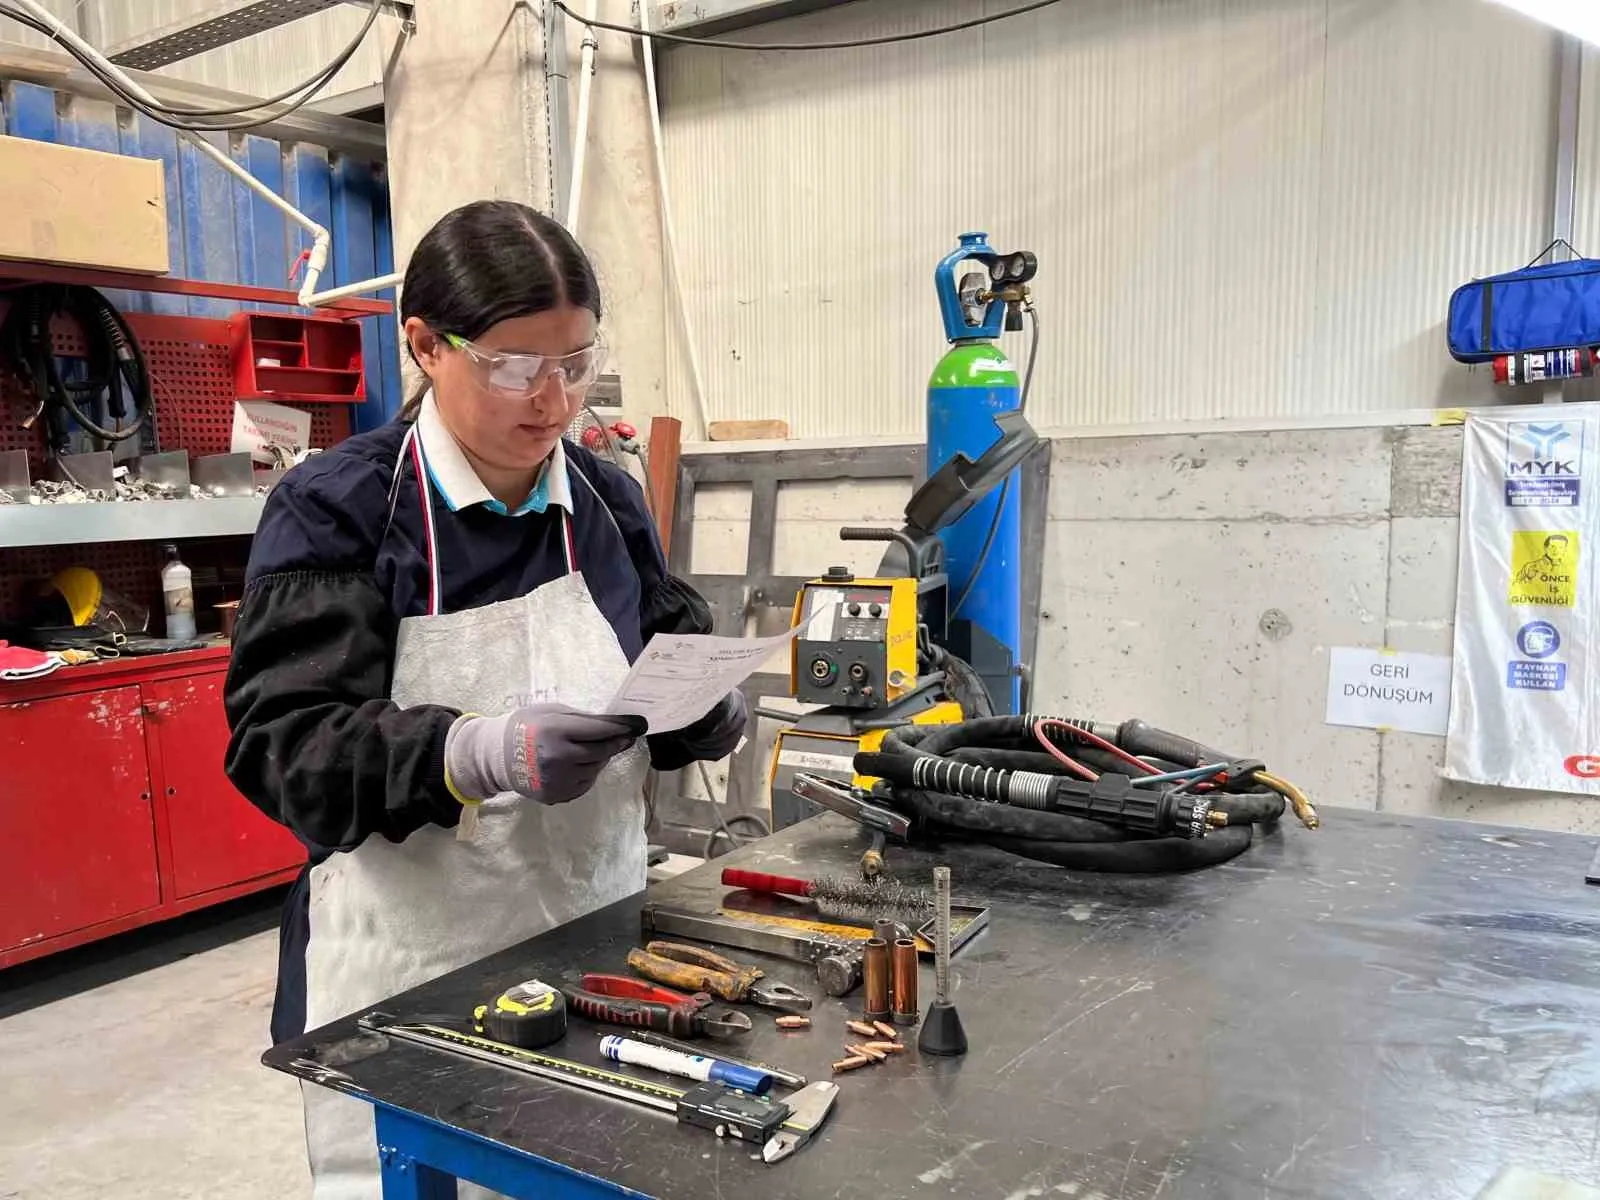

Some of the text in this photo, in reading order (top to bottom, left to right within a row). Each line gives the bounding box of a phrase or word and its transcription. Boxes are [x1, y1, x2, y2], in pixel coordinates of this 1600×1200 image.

[1510, 460, 1574, 474] MYK
[1540, 574, 1569, 583] ÖNCE
[1370, 663, 1409, 679] GERİ
